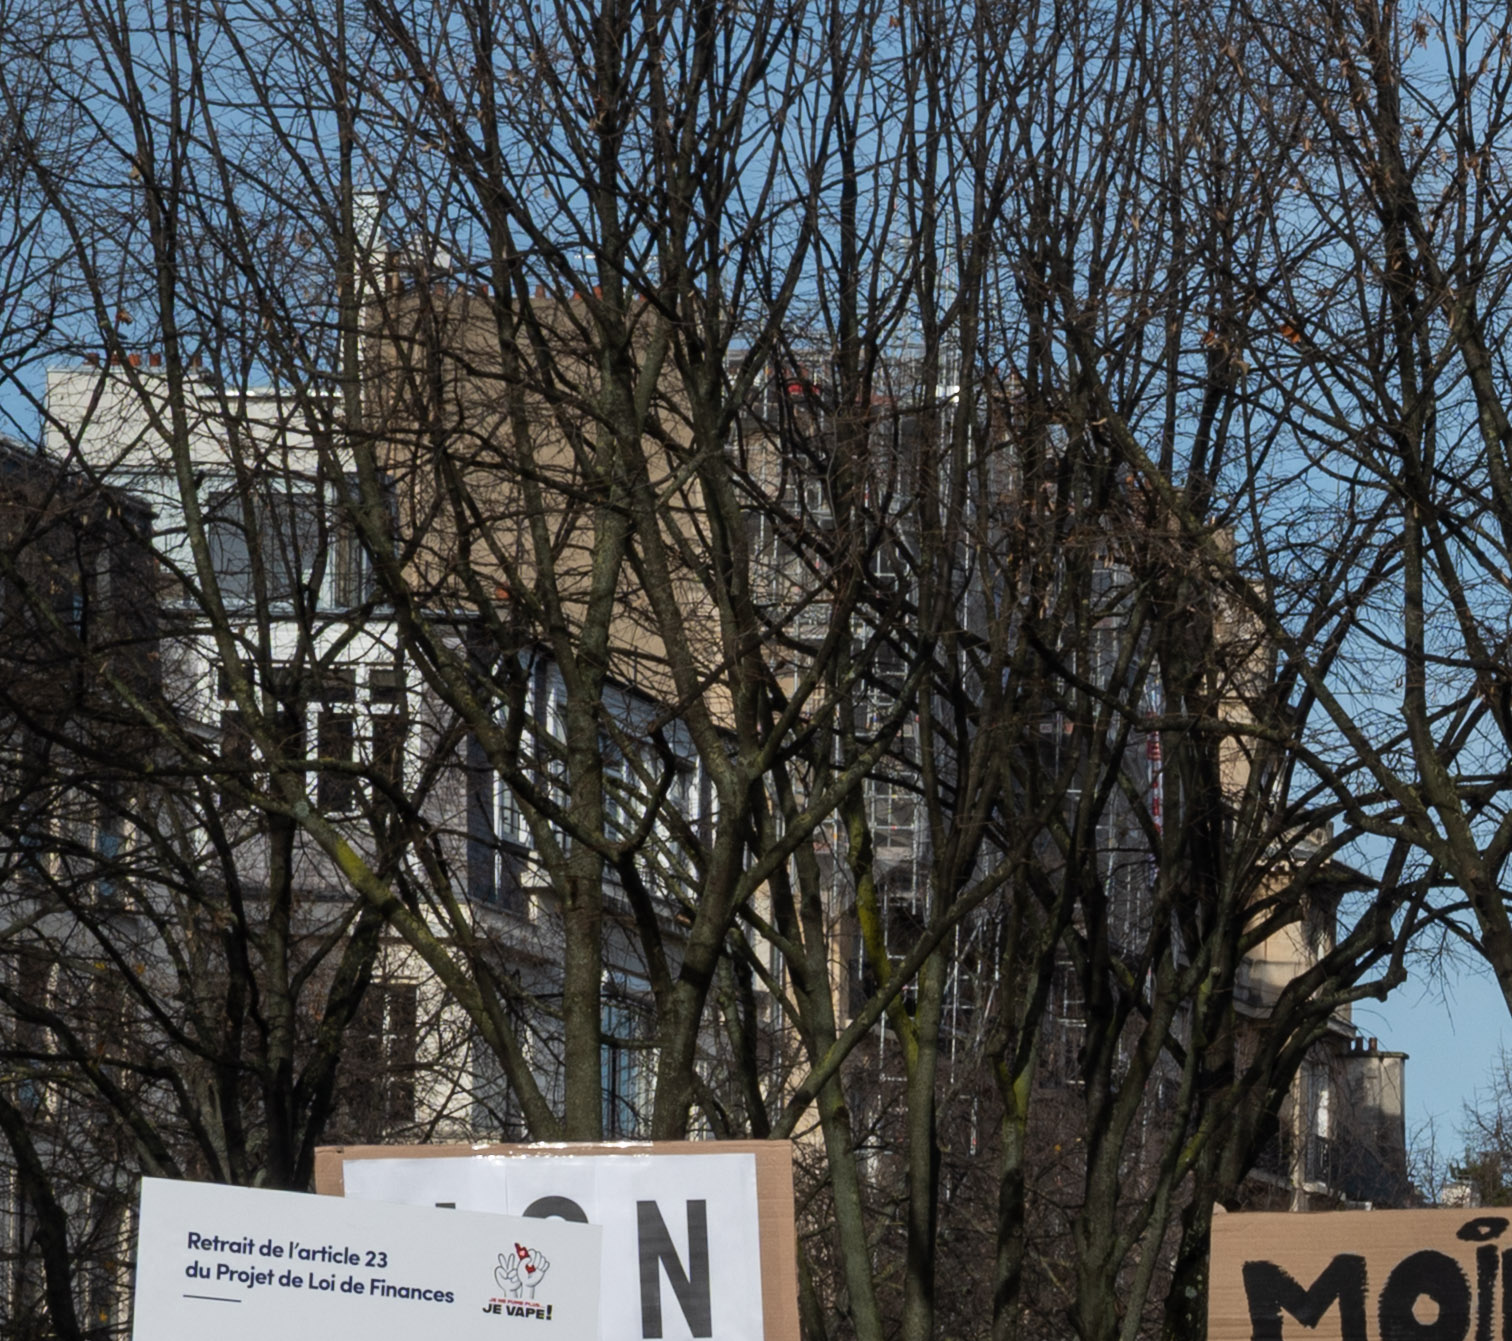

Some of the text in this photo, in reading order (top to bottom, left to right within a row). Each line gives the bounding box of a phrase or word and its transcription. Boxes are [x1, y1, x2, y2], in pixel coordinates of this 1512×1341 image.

[187, 1231, 388, 1269] Retrait de l'article 23
[185, 1260, 455, 1304] du Projet de Loi de Finances
